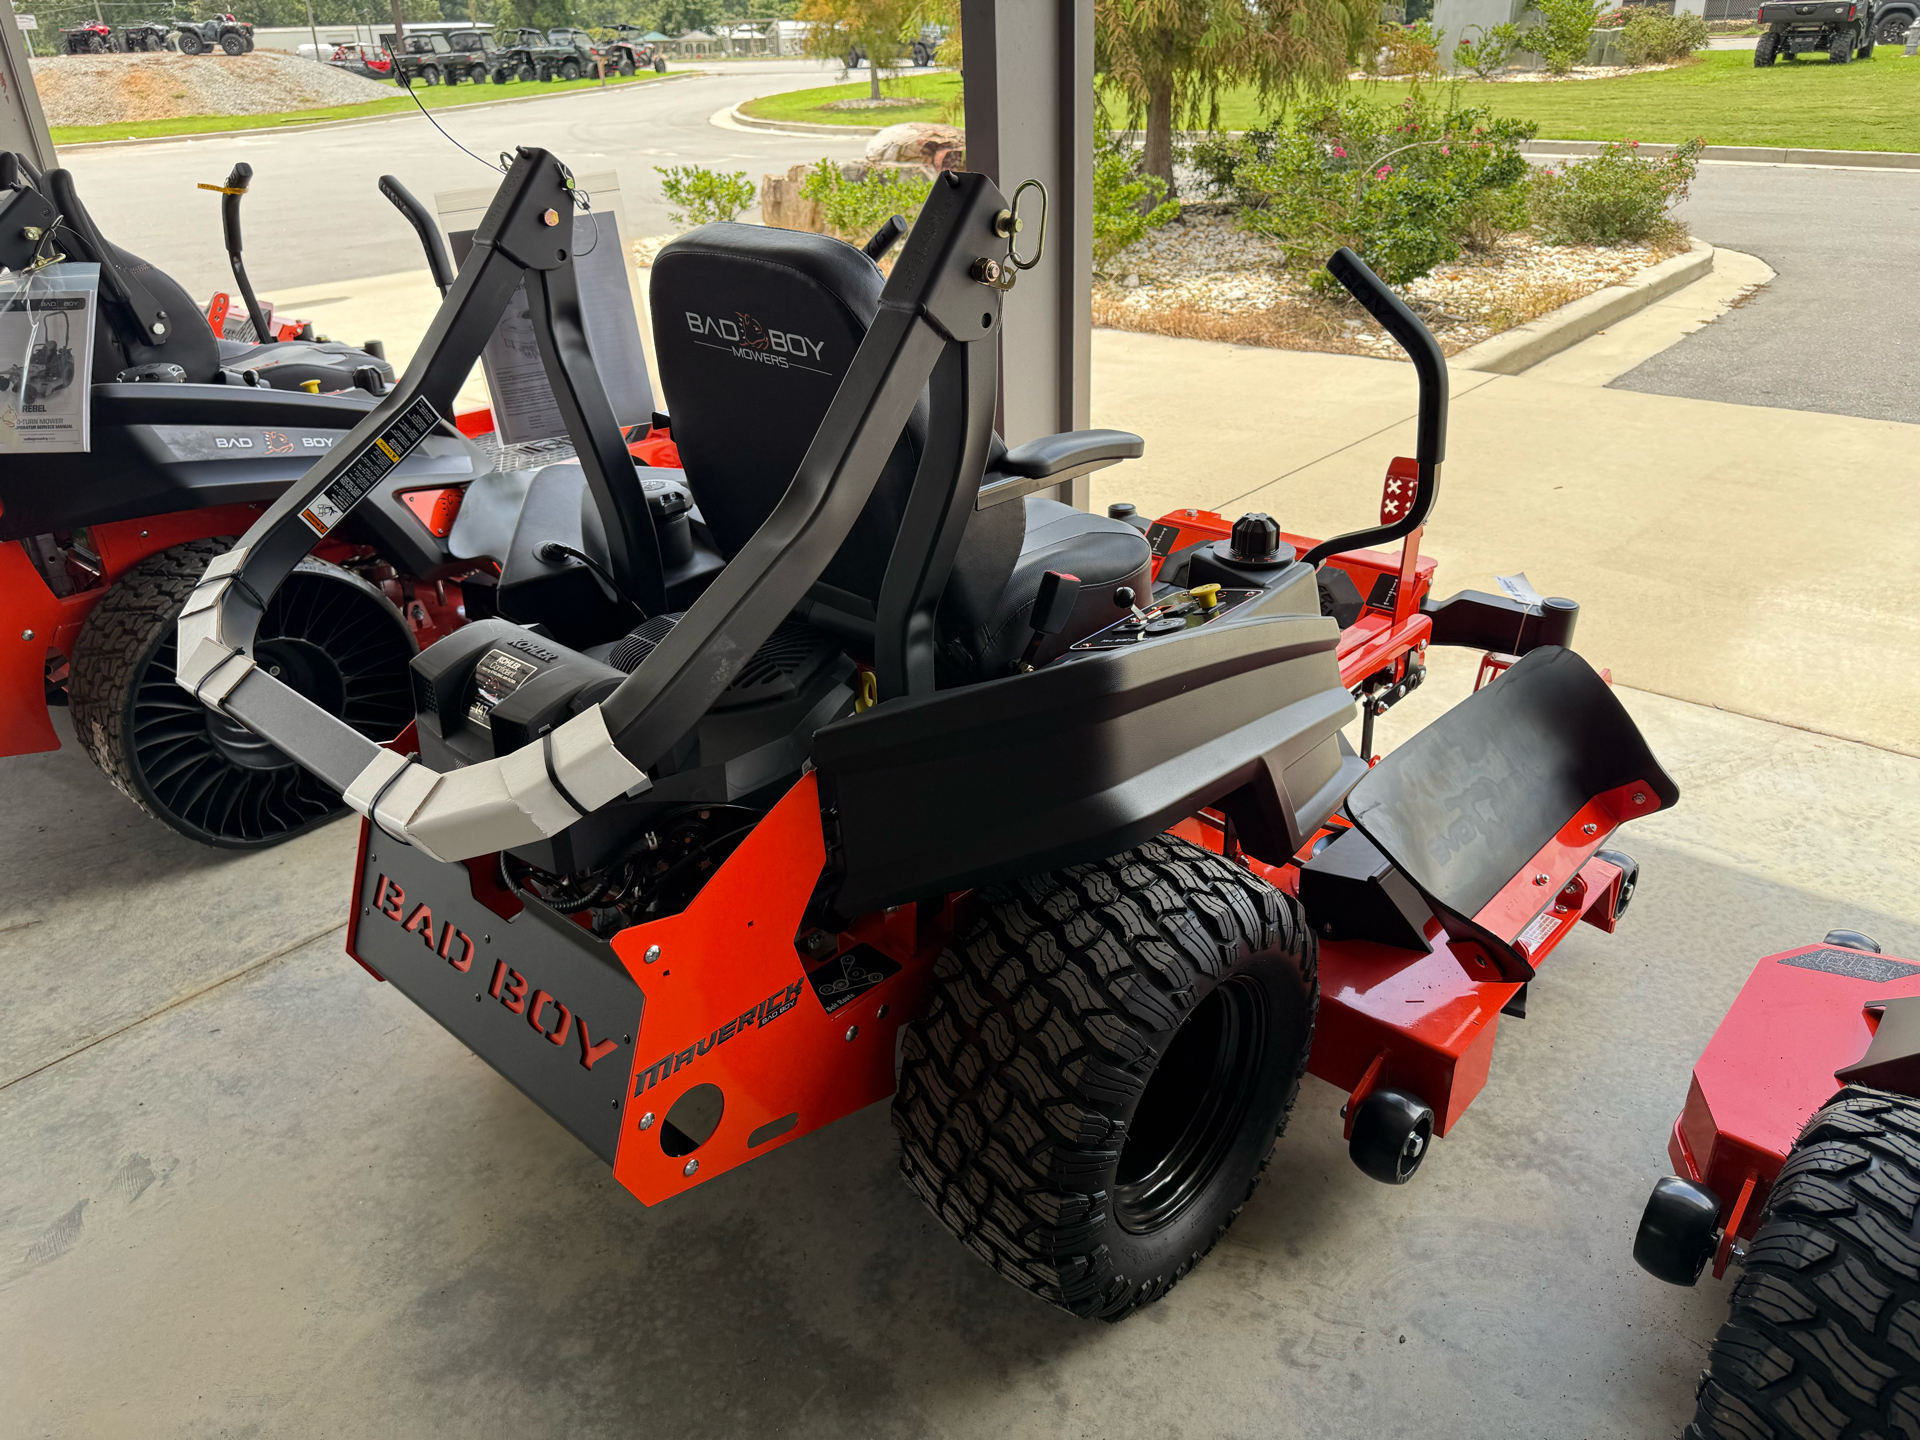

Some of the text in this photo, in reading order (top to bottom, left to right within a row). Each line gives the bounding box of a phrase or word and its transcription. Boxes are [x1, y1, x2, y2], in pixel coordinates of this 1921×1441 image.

[684, 311, 825, 361] BAD BOY
[731, 345, 789, 369] MOWERS
[22, 404, 47, 413] REBEL
[39, 417, 64, 425] MOWER
[215, 437, 334, 448] BAD BOY
[507, 638, 558, 664] KOHLER
[490, 661, 517, 677] Confident
[496, 656, 522, 671] KOHLER
[372, 872, 619, 1072] BAD BOY
[762, 1000, 796, 1025] BAD BOY
[825, 992, 856, 1013] Belt Route
[633, 975, 805, 1098] MAVERICK
